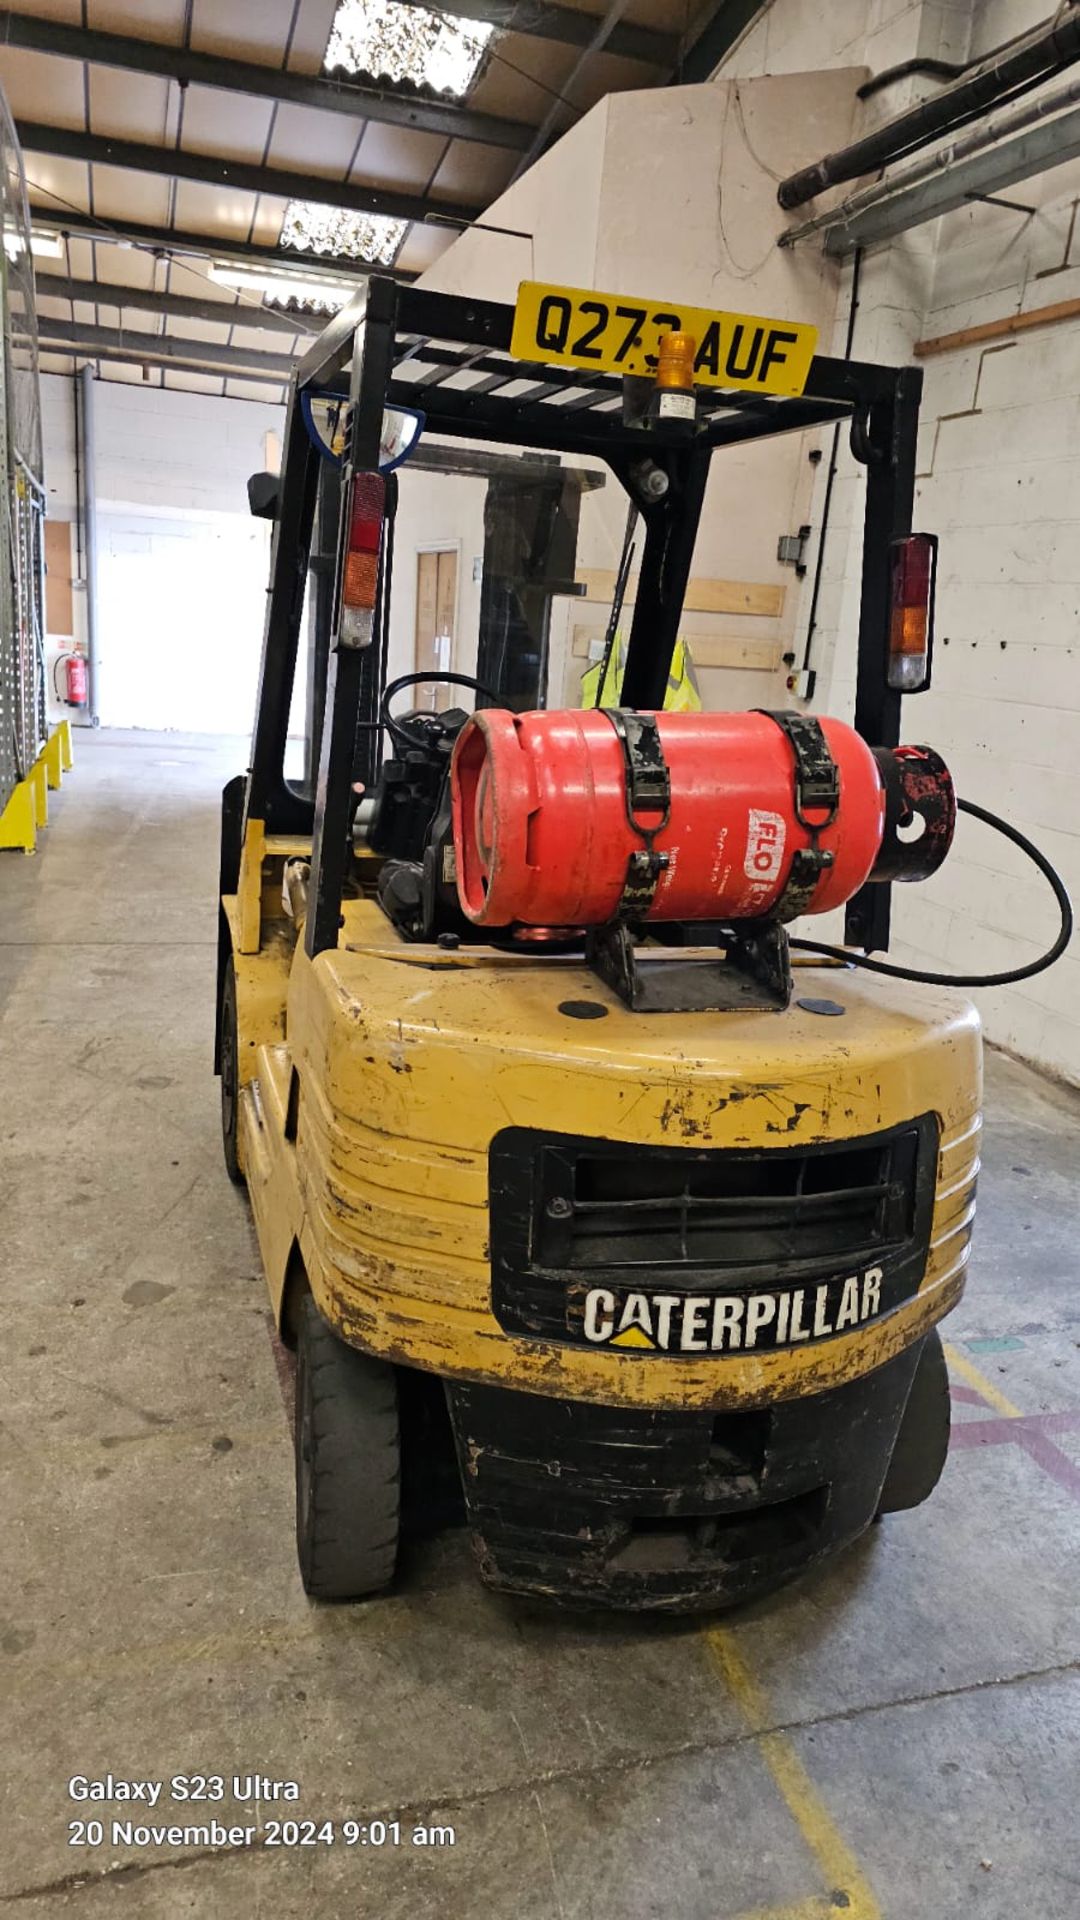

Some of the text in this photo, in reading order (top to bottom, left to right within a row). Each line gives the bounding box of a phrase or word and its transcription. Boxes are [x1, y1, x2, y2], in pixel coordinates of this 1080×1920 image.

[694, 320, 798, 382] AUF
[753, 822, 777, 871] FLO
[583, 1267, 883, 1351] CATERPILLAR
